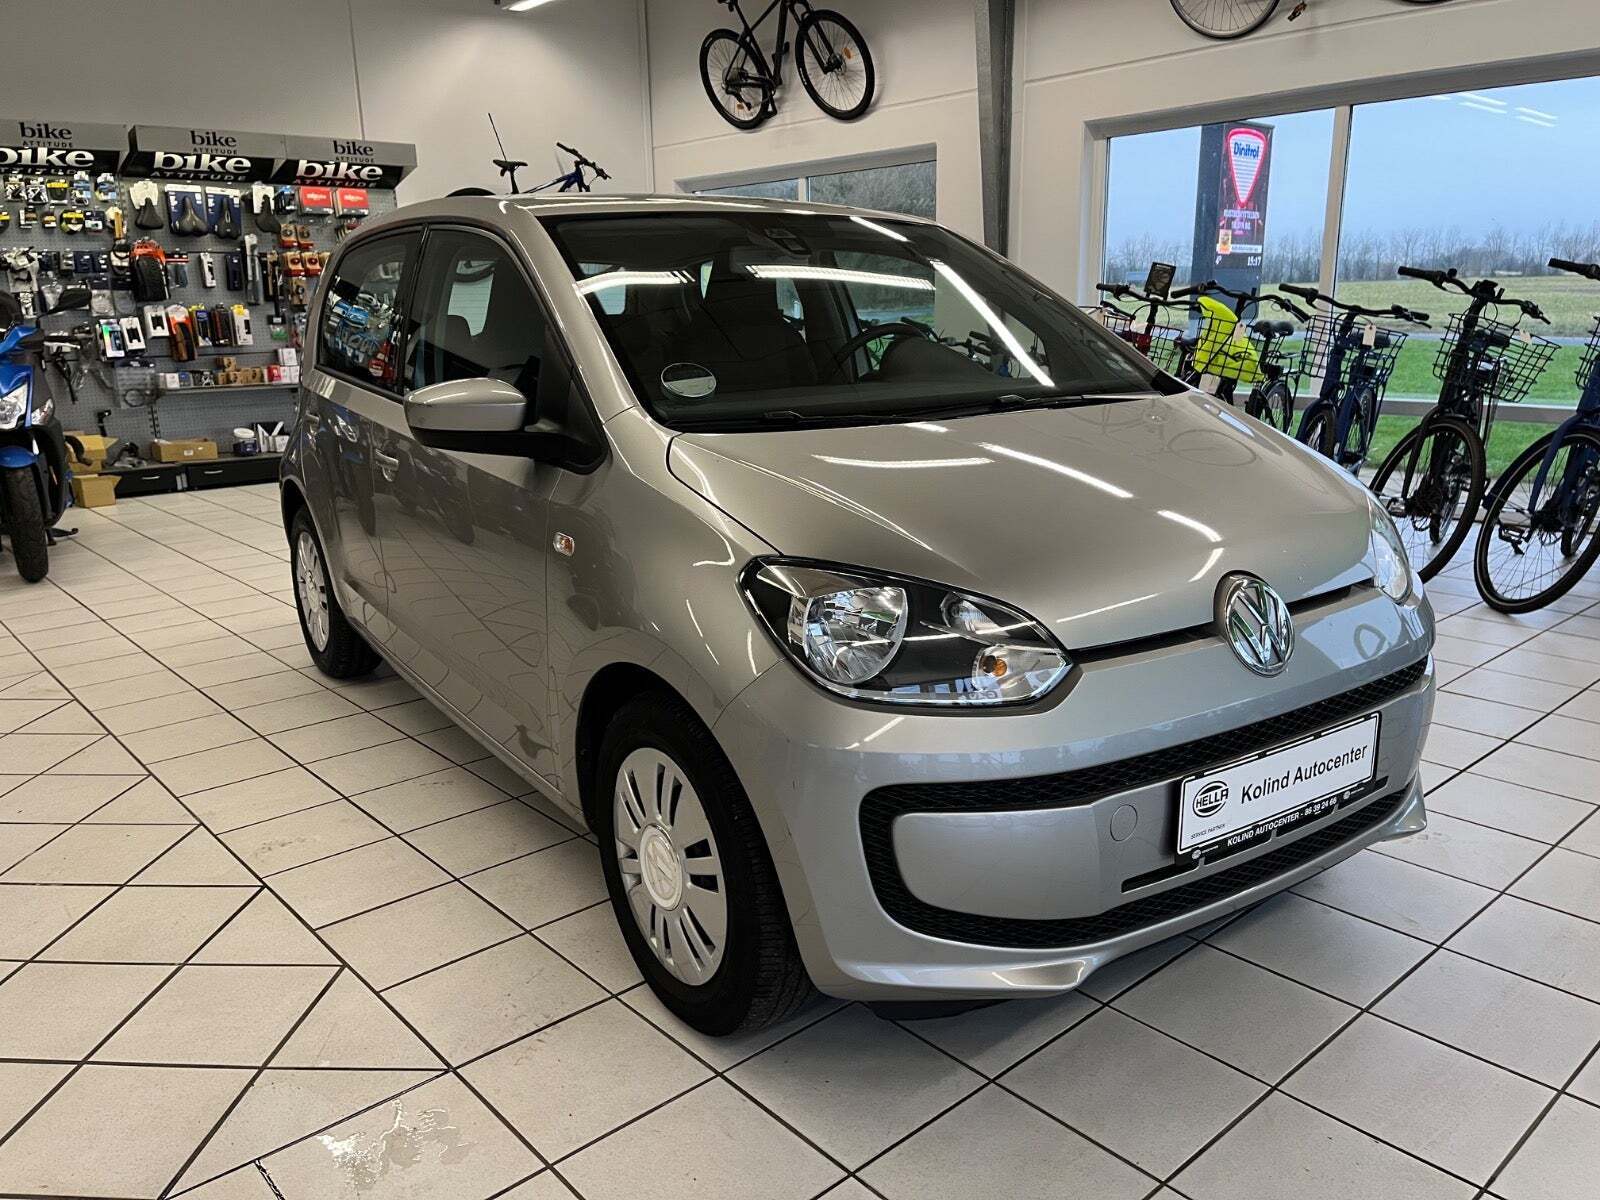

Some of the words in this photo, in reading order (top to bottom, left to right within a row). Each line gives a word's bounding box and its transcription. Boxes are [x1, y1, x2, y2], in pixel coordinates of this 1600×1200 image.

[19, 122, 72, 139] bike
[190, 130, 237, 147] bike
[22, 140, 73, 148] ATTITUDE
[192, 147, 237, 155] ATTITUDE
[333, 140, 374, 156] bike
[1233, 141, 1260, 159] Dinitrol
[153, 151, 251, 173] bike
[296, 159, 383, 181] bike
[150, 171, 246, 181] ATTITUDE
[293, 179, 377, 188] ATTITUDE
[1240, 770, 1290, 804] Kolind
[1293, 745, 1368, 785] Autocenter
[1195, 787, 1229, 809] HELLA
[1227, 830, 1254, 847] KOLIND
[1254, 811, 1299, 835] AUTOCENTER
[1313, 803, 1321, 812] 39
[1190, 828, 1207, 840] SERVICE
